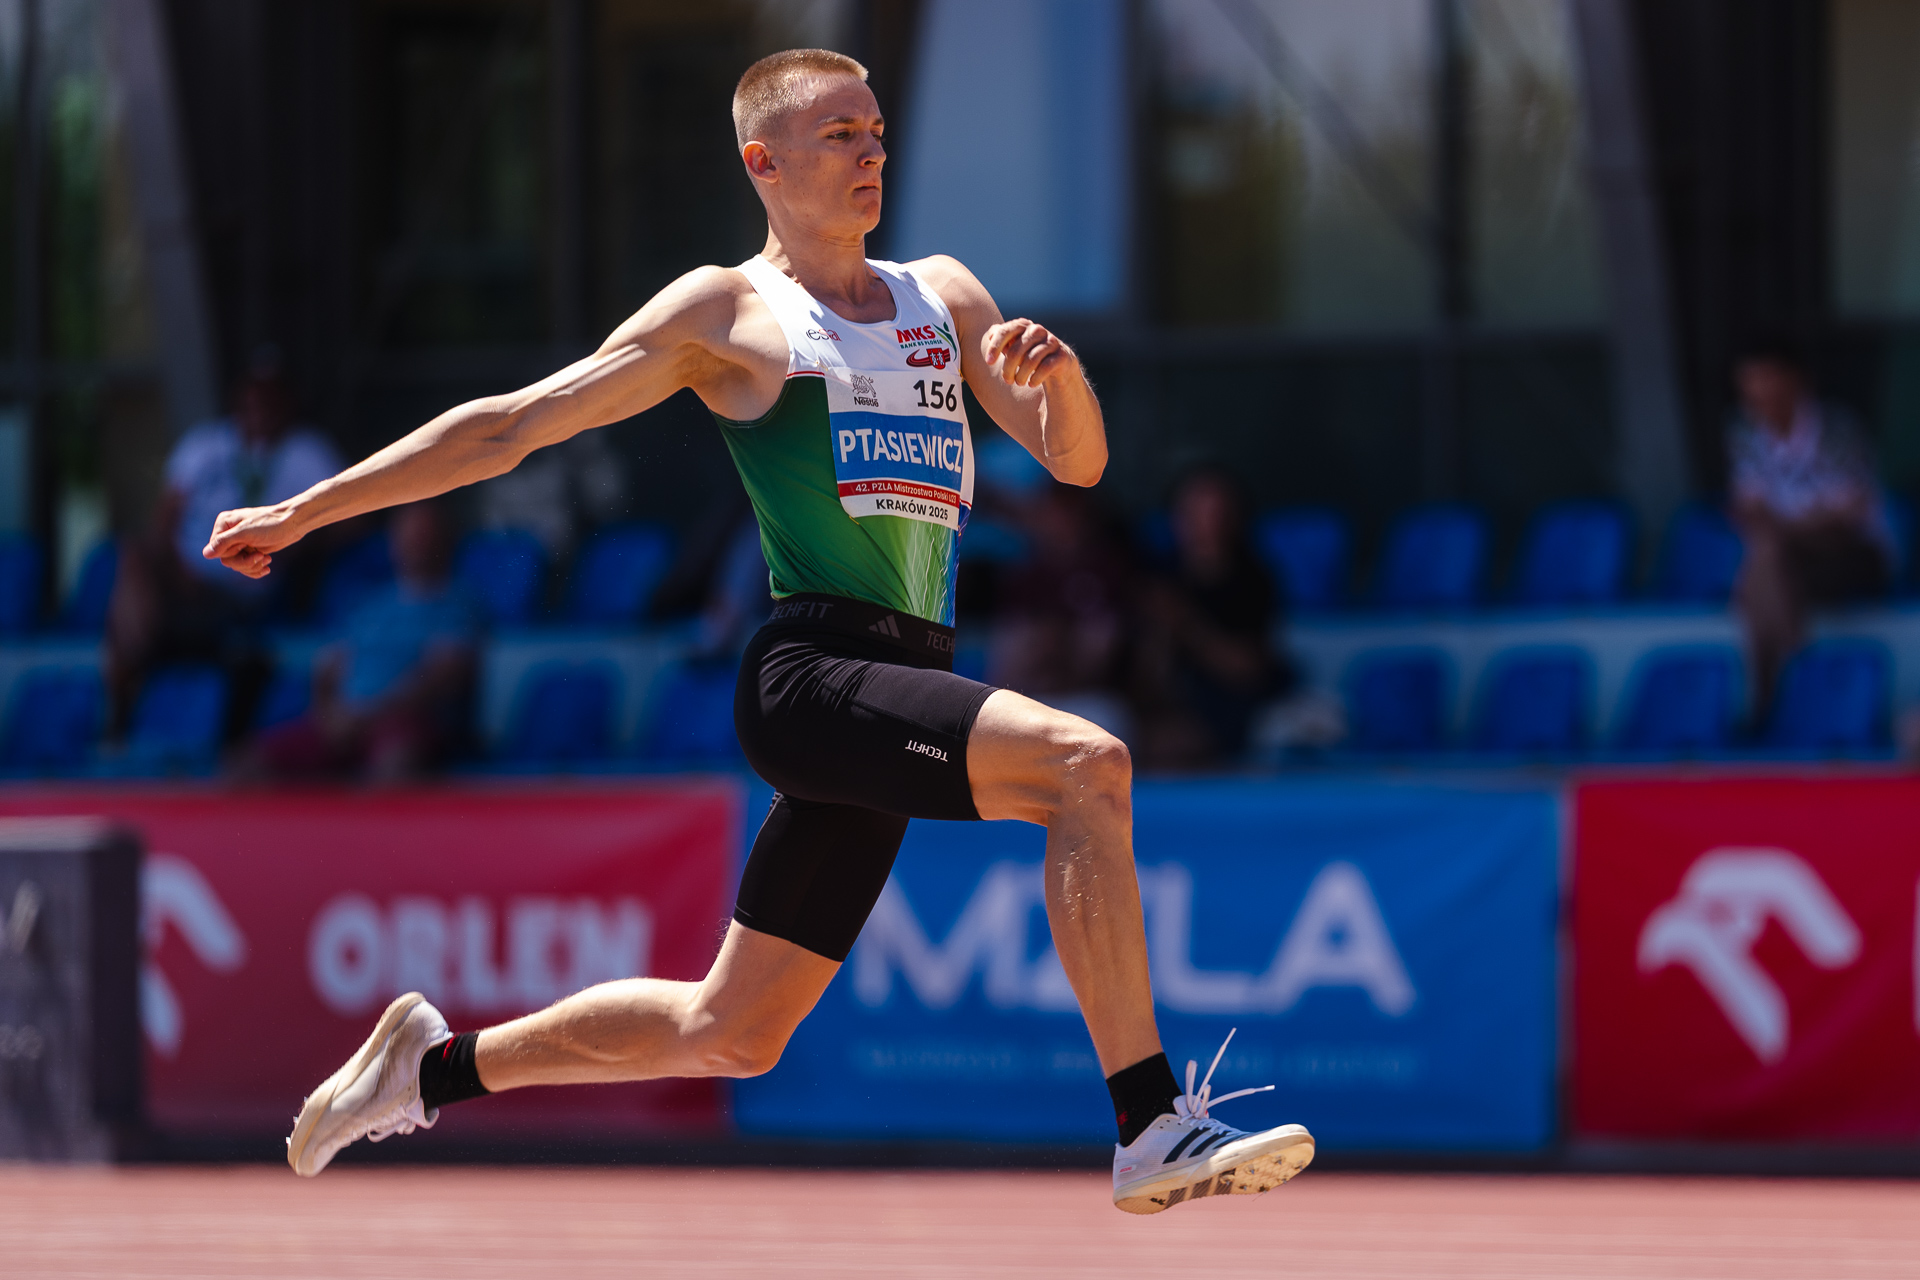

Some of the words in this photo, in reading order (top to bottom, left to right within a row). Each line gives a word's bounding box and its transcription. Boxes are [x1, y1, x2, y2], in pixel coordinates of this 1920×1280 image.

[895, 324, 936, 343] MKS
[913, 379, 957, 412] 156
[838, 428, 963, 474] PTASIEWICZ
[855, 483, 870, 492] 42.
[871, 482, 893, 491] PZLA
[894, 483, 933, 497] Mistrzostwa
[933, 490, 949, 500] Polski
[875, 499, 927, 516] KRAKÓW
[928, 505, 949, 521] 2025
[904, 739, 949, 762] TECHFIT
